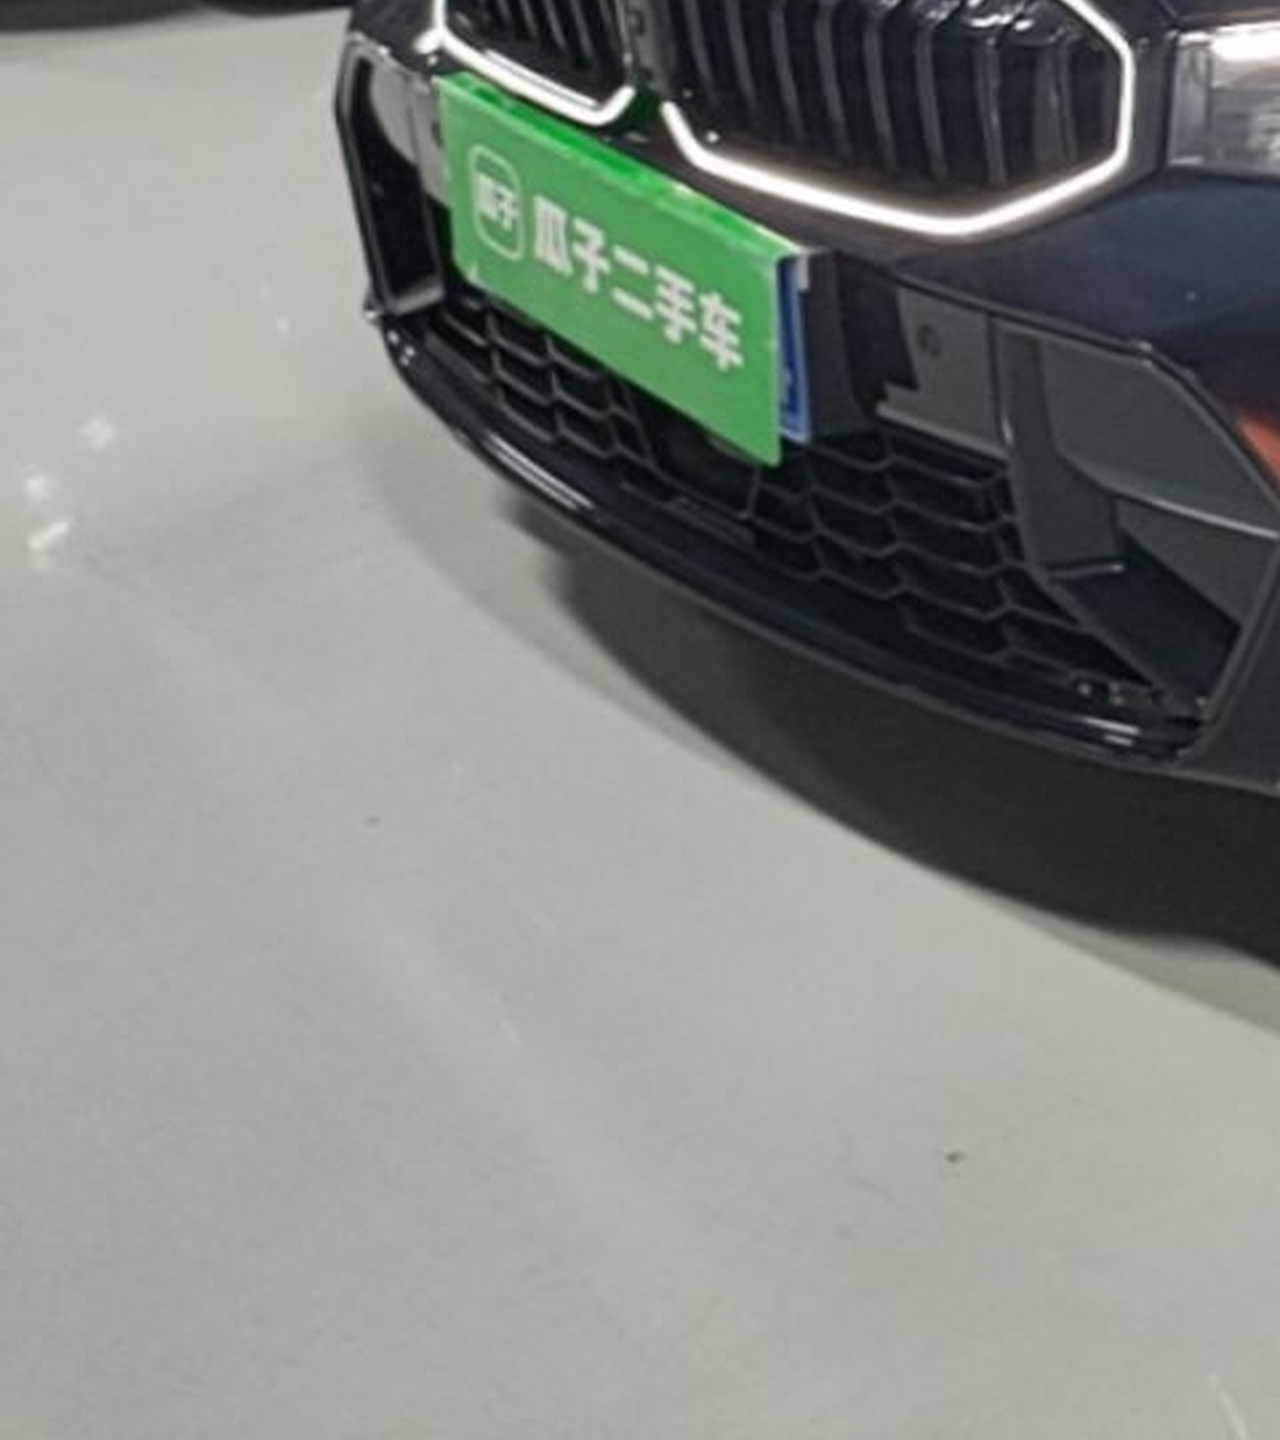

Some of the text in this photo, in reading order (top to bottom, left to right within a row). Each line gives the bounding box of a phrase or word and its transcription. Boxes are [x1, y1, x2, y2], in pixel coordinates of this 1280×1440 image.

[533, 194, 745, 372] 瓜子二手车
